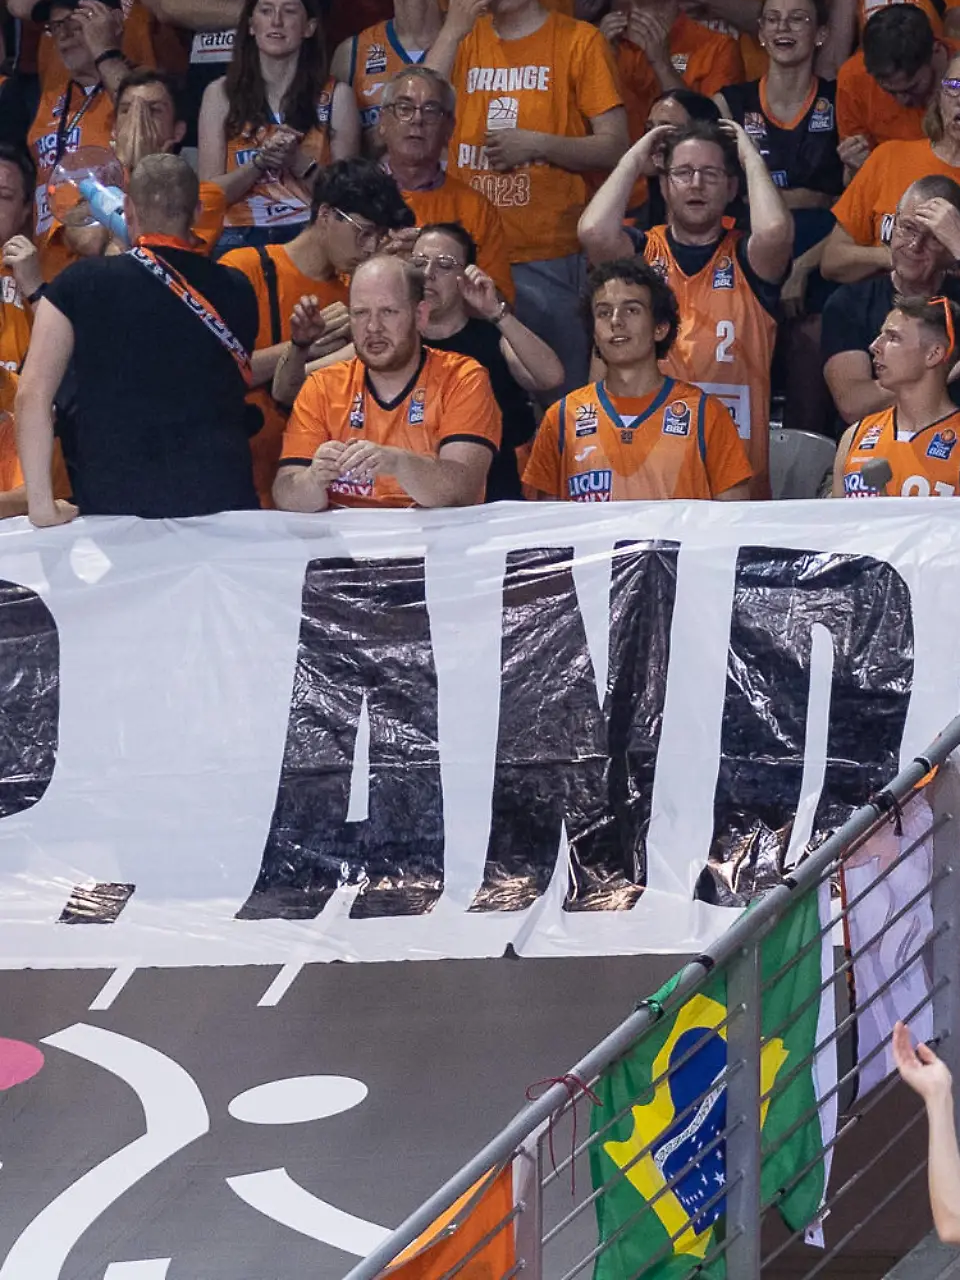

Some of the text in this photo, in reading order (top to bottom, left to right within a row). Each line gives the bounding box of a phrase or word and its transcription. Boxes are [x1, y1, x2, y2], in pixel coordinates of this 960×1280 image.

[466, 67, 550, 93] ORANGE
[456, 142, 489, 171] PLA
[715, 320, 735, 363] 2
[567, 470, 610, 499] LIQUI
